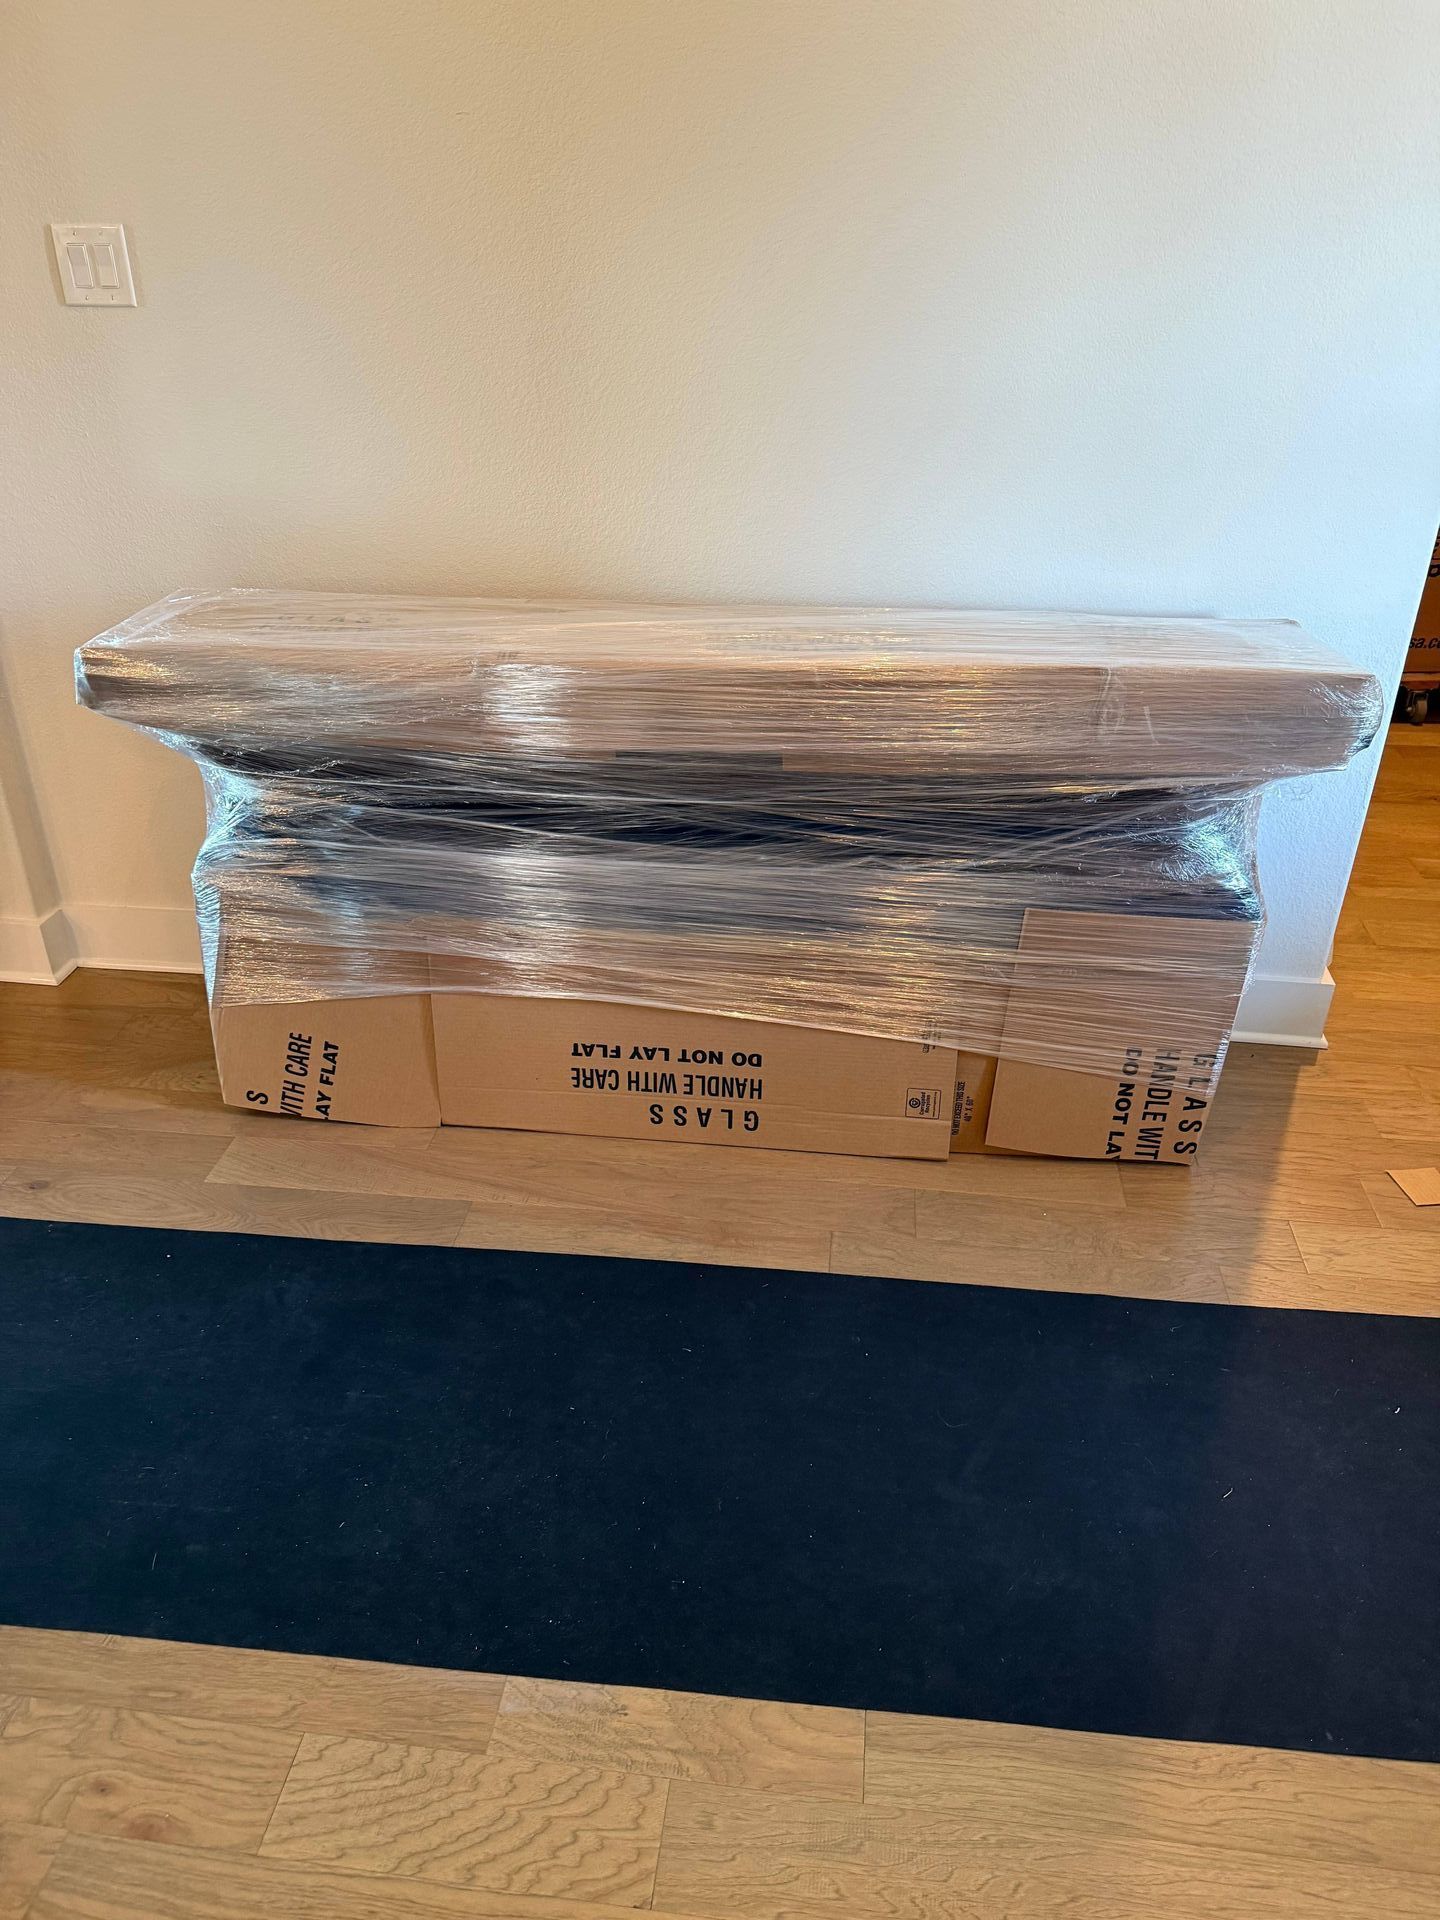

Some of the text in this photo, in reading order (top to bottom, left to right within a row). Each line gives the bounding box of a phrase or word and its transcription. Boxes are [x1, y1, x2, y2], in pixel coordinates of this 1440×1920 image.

[280, 1032, 312, 1117] ITH CARE
[571, 1042, 763, 1068] DO NOT LAY FLAT
[1122, 1046, 1143, 1076] DO
[315, 1040, 339, 1120] AY FLAT
[570, 1067, 763, 1100] HANDLE WITH CARE
[1141, 1048, 1182, 1122] HANDLE
[1111, 1082, 1136, 1125] NOT
